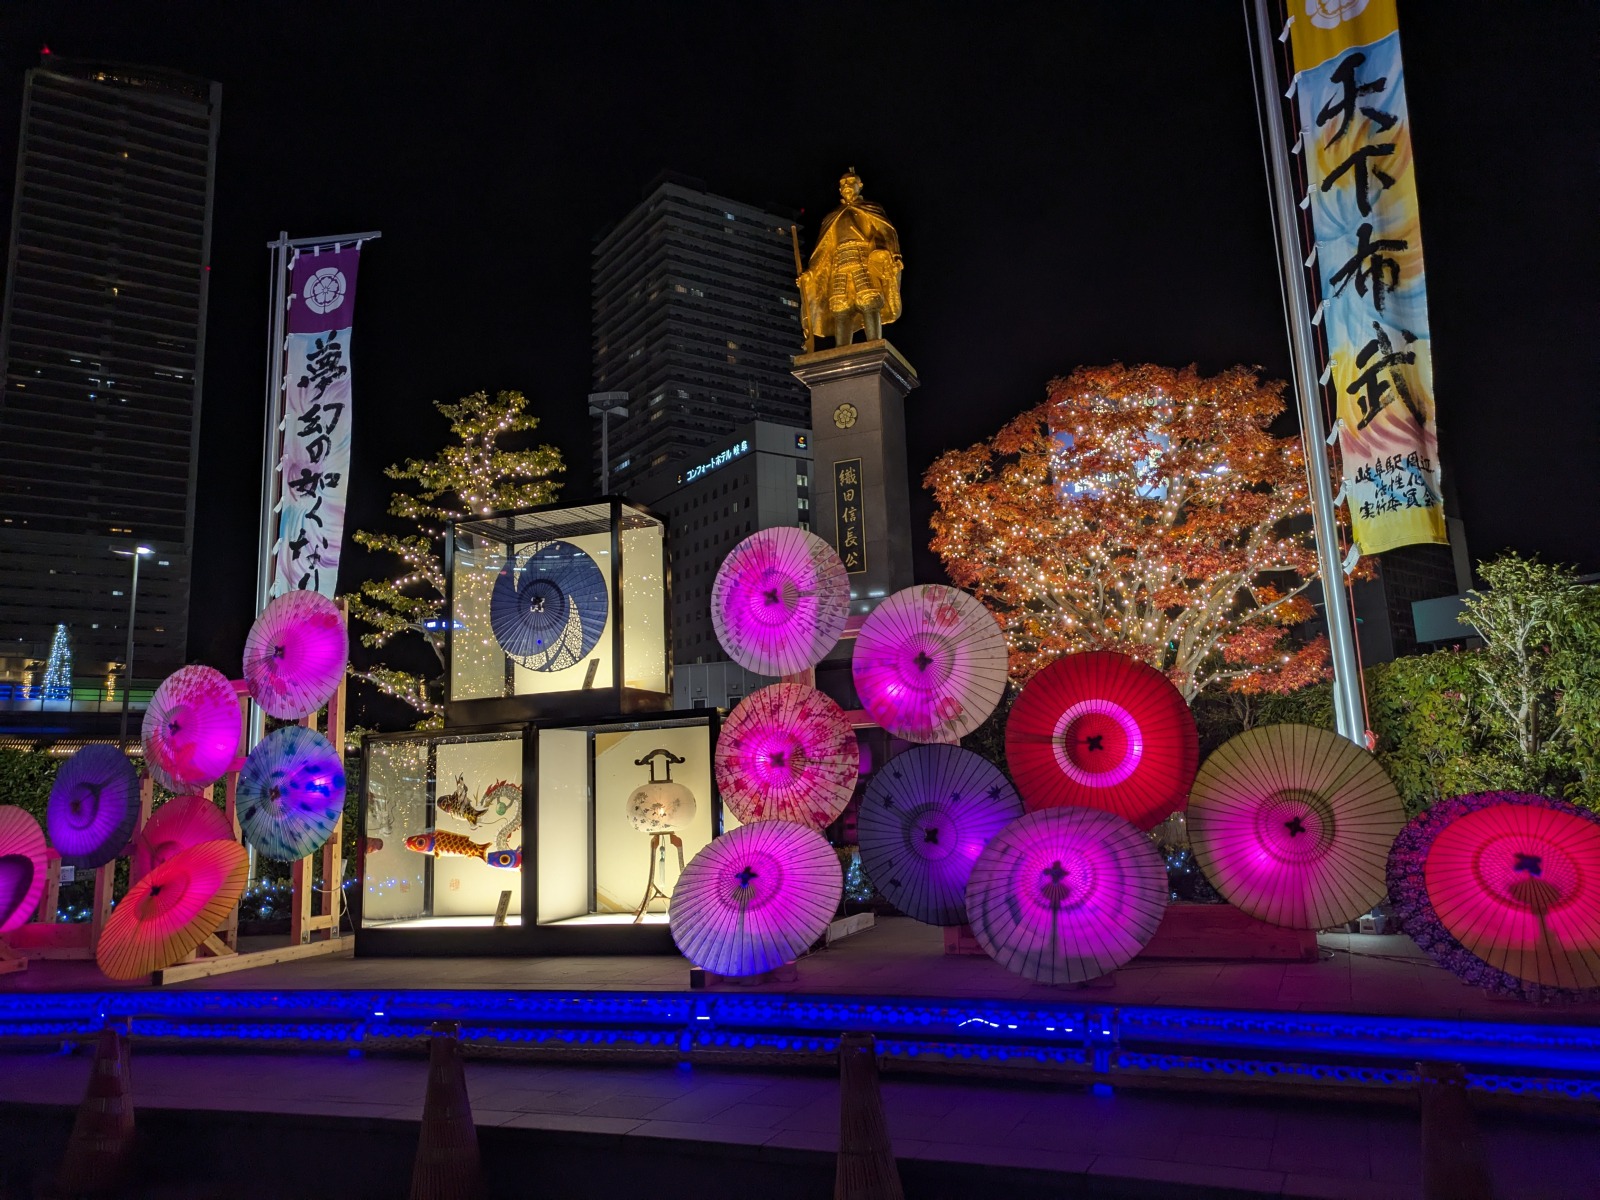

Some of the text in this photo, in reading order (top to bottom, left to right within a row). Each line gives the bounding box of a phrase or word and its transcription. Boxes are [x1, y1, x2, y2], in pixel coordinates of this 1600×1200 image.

[1316, 52, 1427, 430] 天下布武
[839, 467, 859, 567] 織田信長公
